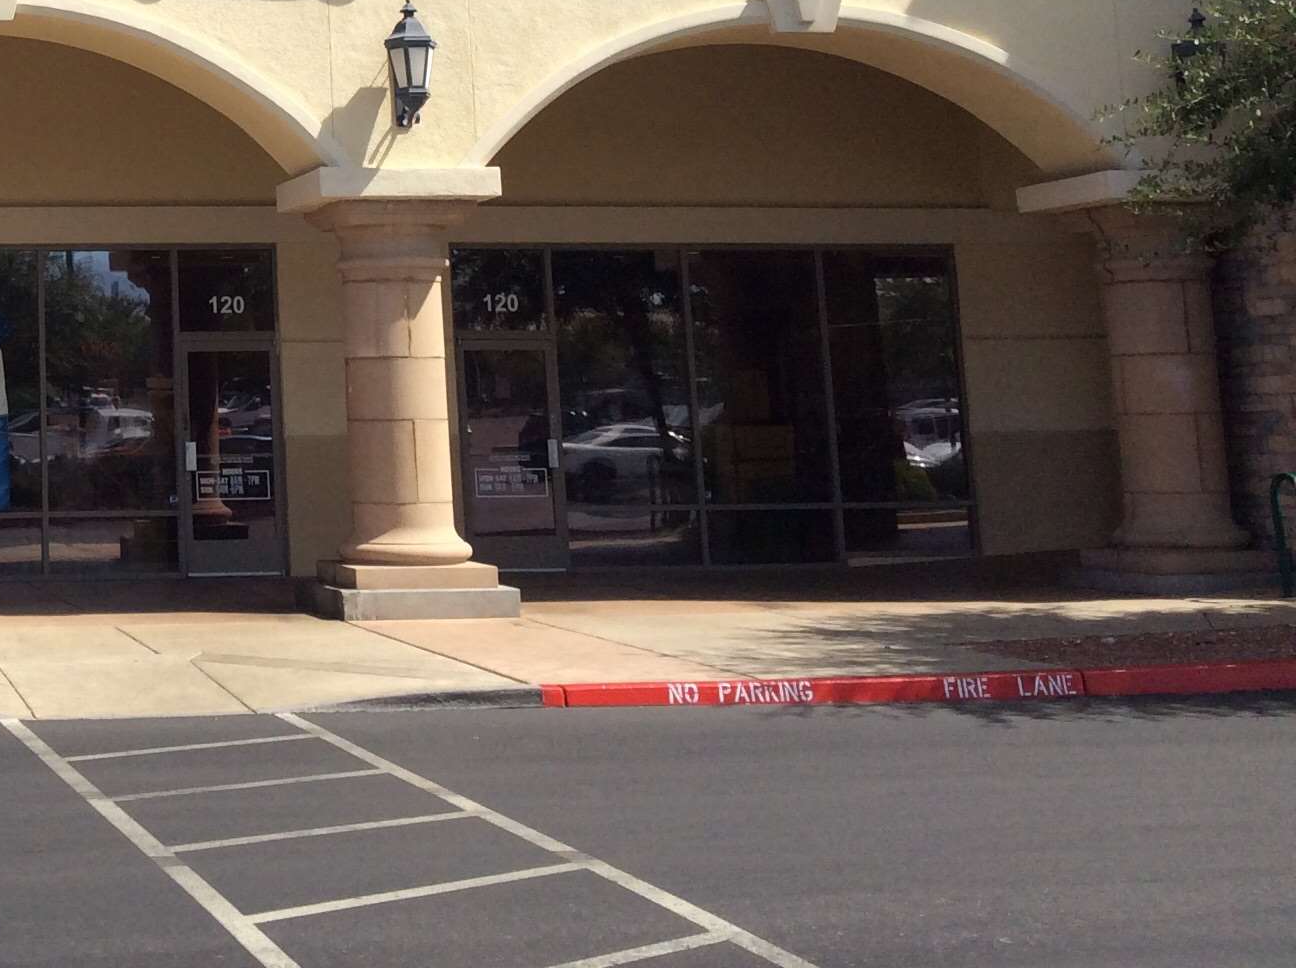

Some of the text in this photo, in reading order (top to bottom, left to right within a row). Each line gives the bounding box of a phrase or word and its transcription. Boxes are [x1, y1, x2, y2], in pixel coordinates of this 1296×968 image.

[208, 295, 245, 314] 120
[483, 293, 519, 312] 120
[668, 680, 814, 704] NO PARKING
[943, 674, 1077, 699] FIRE LANE
